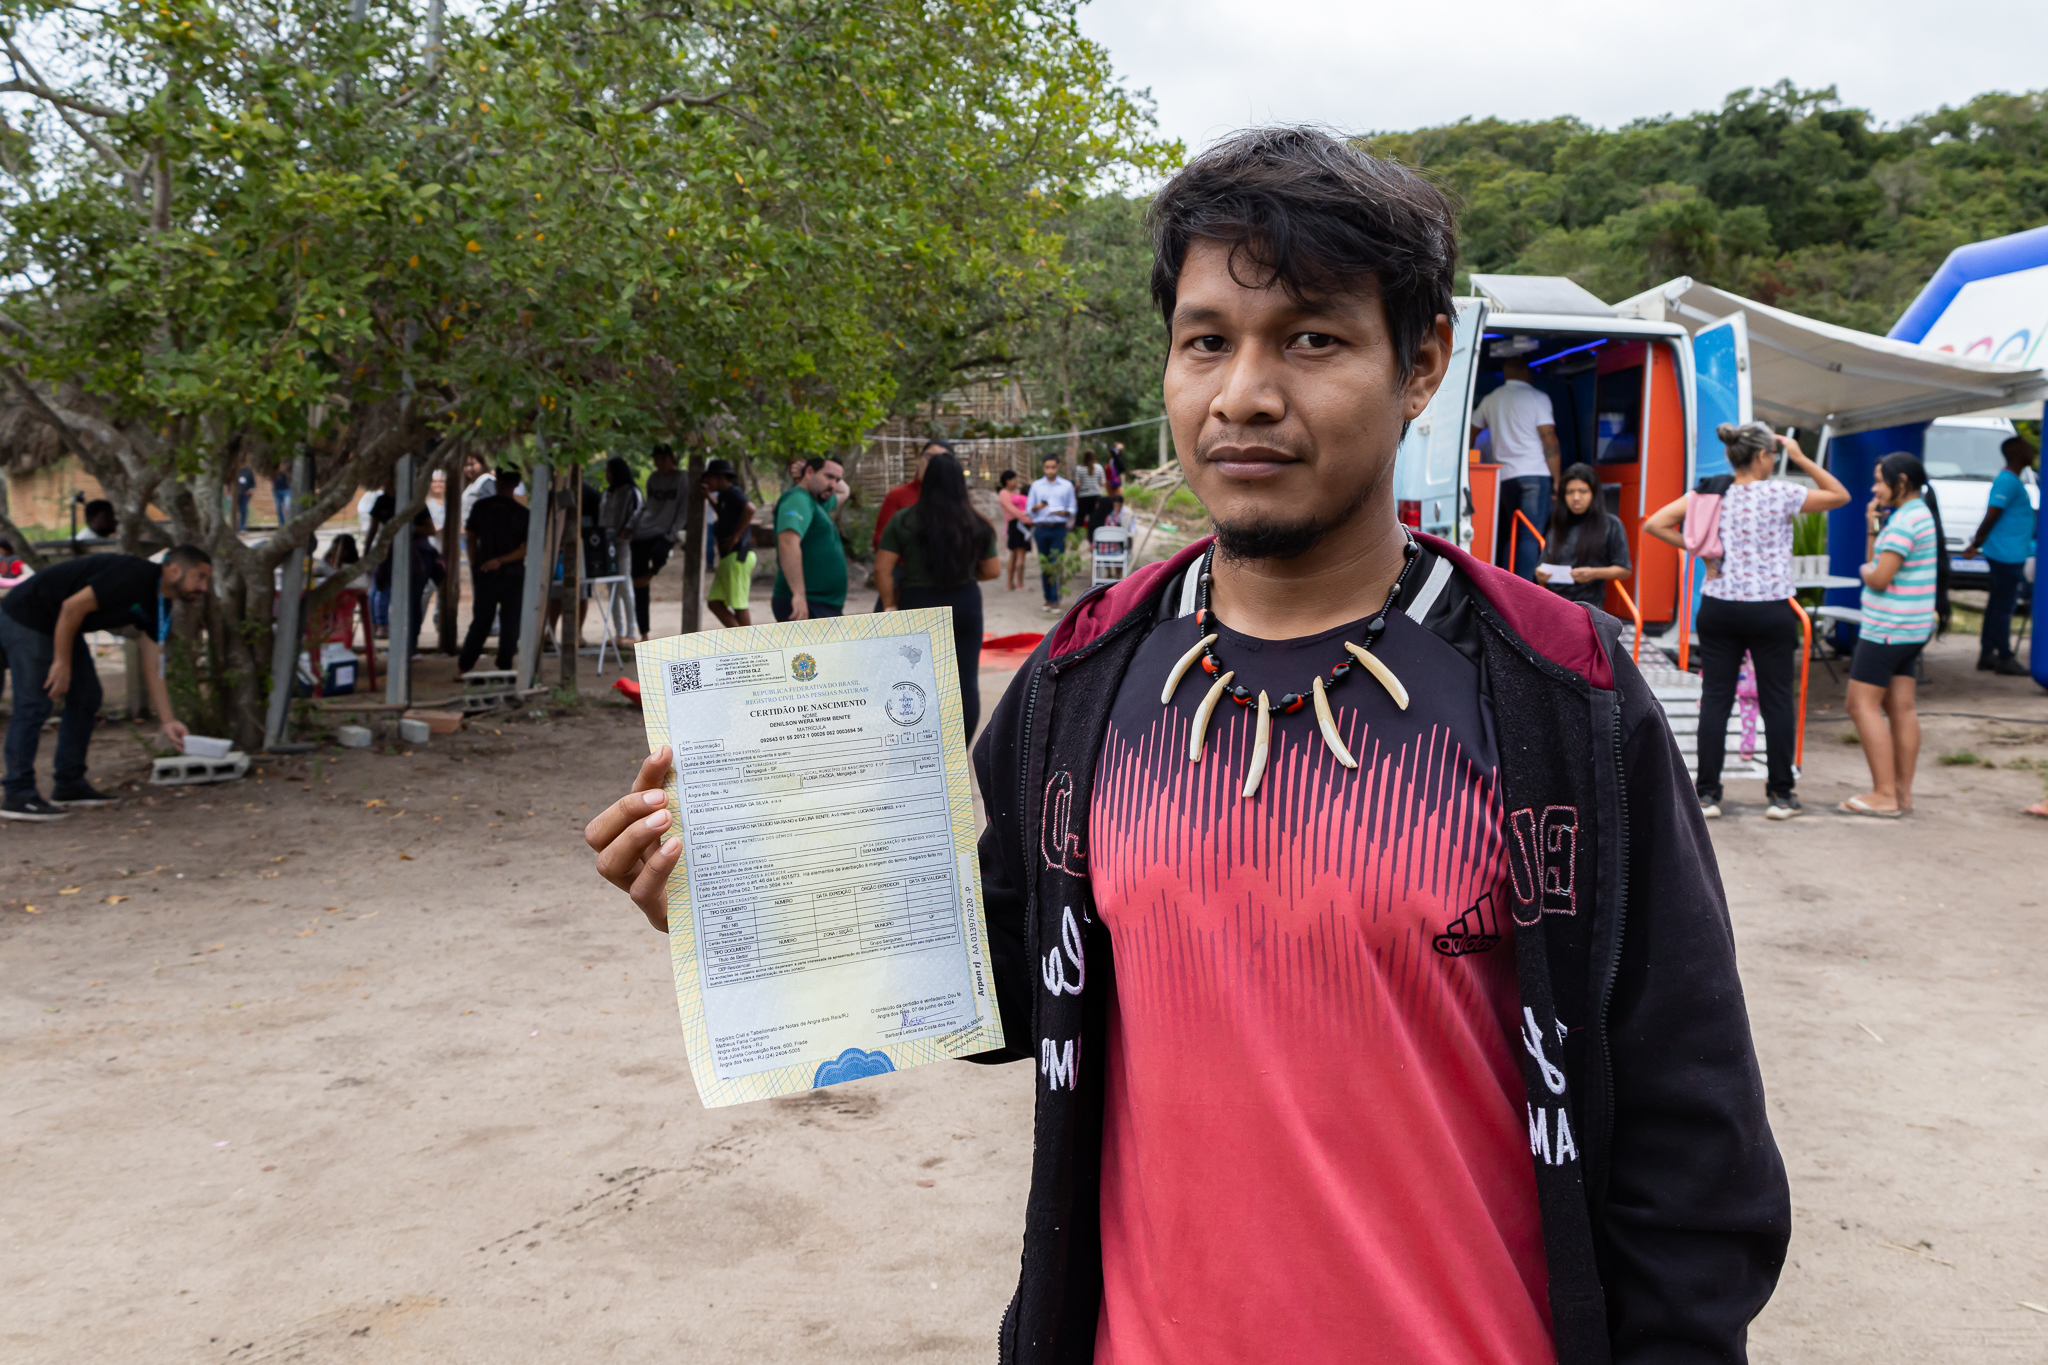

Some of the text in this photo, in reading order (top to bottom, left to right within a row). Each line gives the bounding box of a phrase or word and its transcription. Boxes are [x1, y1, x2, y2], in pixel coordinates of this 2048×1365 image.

[745, 697, 778, 706] REGISTRO
[810, 690, 838, 698] PESSOAS
[838, 687, 869, 695] NATURAIS
[752, 687, 788, 697] REPÚBLICA
[789, 684, 827, 693] FEDERATIVA
[749, 698, 867, 718] CERTIDÃO DE NASCIMENTO
[972, 943, 980, 955] AA
[1433, 934, 1501, 957] adidas
[972, 961, 983, 972] rj
[975, 972, 985, 996] Arpen
